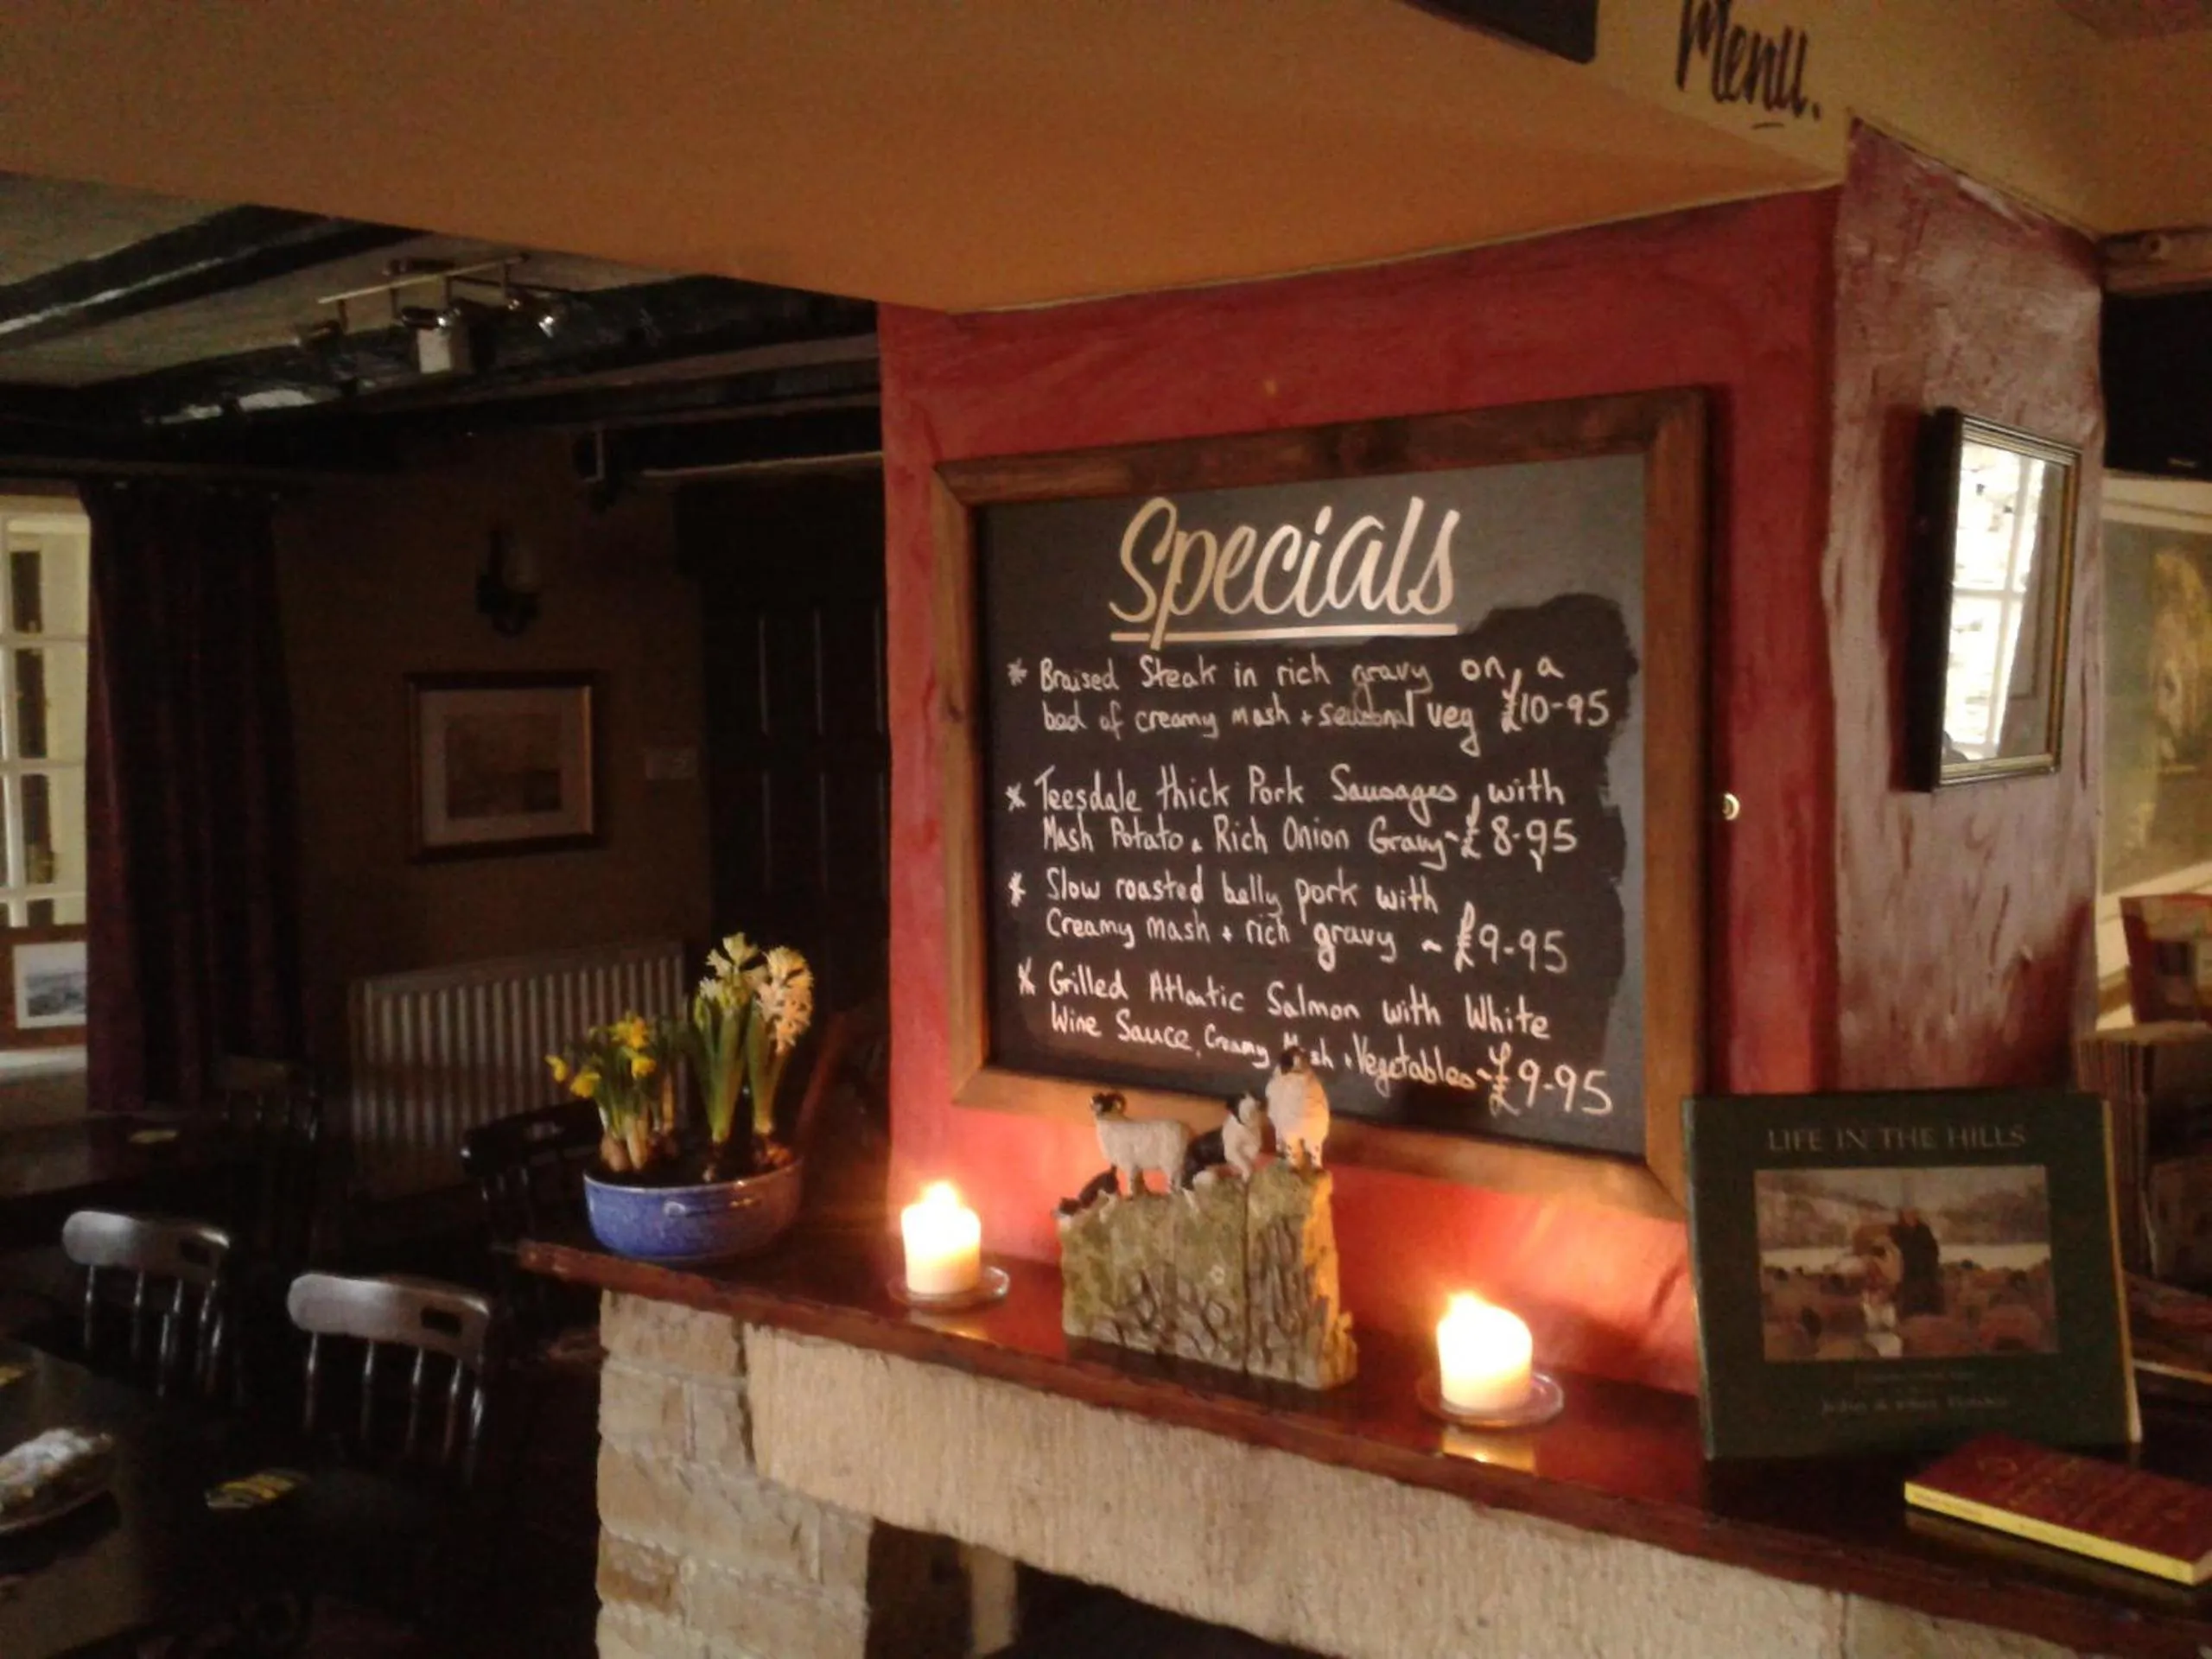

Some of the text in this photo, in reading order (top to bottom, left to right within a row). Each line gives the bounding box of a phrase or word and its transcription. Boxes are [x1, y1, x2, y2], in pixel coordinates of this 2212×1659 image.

[1109, 497, 1460, 651] Specials
[1039, 652, 1565, 712] Braised Steak in rich gravy on a
[1100, 699, 1122, 741] of
[1135, 708, 1219, 740] creamy
[1427, 702, 1481, 758] veg
[1034, 763, 1566, 829] Teesdale thick Pork Sausages with
[1043, 812, 1094, 853] Mash
[1110, 813, 1185, 852] Potato
[1213, 814, 1268, 855] Rich
[1283, 816, 1350, 852] Onion
[1046, 864, 1439, 925] Slow roasted belly pork with
[1046, 907, 1135, 949] Creamy
[1146, 908, 1210, 944] mash
[1245, 915, 1291, 946] rich
[1313, 923, 1398, 972] gravy
[1049, 960, 1552, 1039] Grilled Atlantic Salmon with White
[1051, 1001, 1103, 1037] Wine
[1767, 1124, 2027, 1152] LIFE IN THE HILLS
